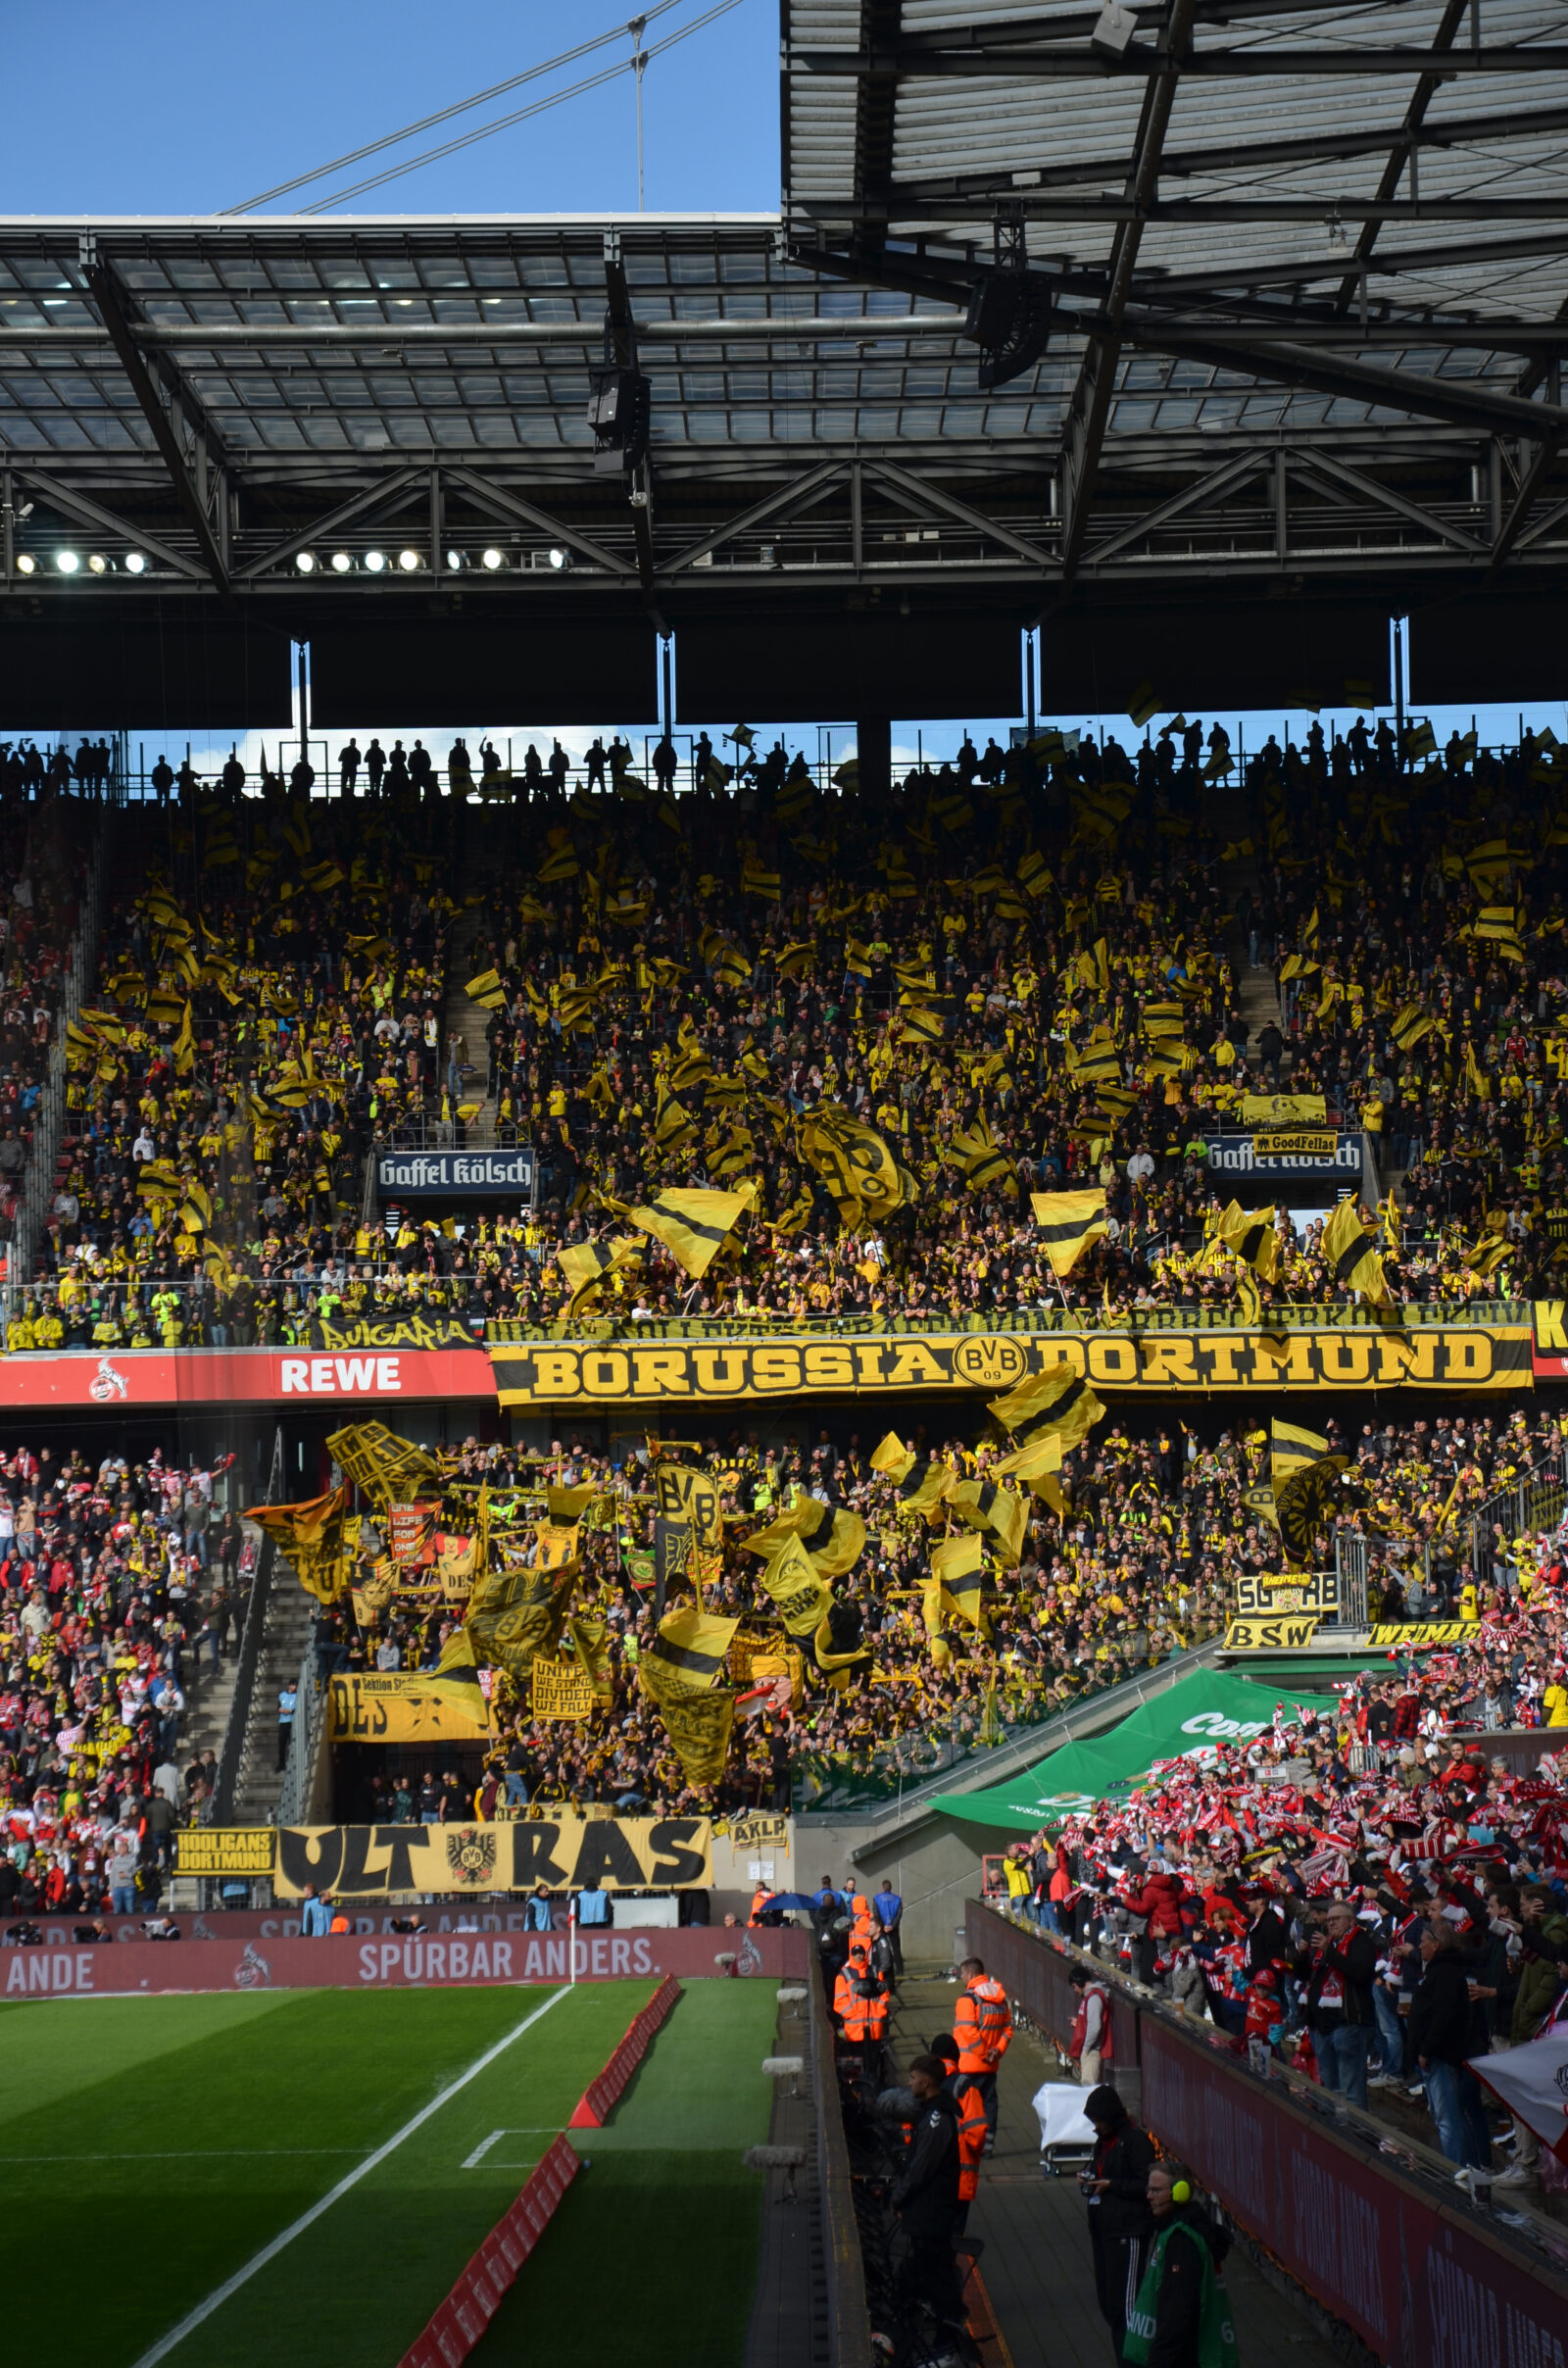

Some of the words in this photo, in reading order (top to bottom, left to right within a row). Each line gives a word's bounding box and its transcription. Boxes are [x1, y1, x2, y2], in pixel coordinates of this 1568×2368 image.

[1272, 1136, 1334, 1150] GoodFellas
[379, 1158, 449, 1187] Gaffel
[454, 1157, 531, 1186] Kölsch
[1535, 1301, 1568, 1348] K
[532, 1340, 949, 1394] BORUSSIA
[1035, 1334, 1493, 1381] DORTMUND
[965, 1340, 1018, 1370] BVB
[281, 1357, 401, 1393] REWE
[983, 1370, 1001, 1380] 09
[393, 1515, 423, 1526] LIFE
[393, 1529, 416, 1539] FOR
[394, 1542, 416, 1552] ONE
[1239, 1579, 1273, 1608] SG
[1230, 1621, 1314, 1648] BSW
[1374, 1622, 1482, 1645] WEIMAR
[362, 1677, 392, 1691] Sektion
[536, 1675, 554, 1686] WE
[536, 1687, 591, 1702] DIVIDED
[535, 1700, 557, 1712] WE
[560, 1702, 591, 1713] FALL
[734, 1819, 785, 1842] AKLP
[177, 1833, 270, 1851] HOOLIGANS
[177, 1850, 270, 1869] DORTMUND
[464, 1849, 481, 1863] BVB
[359, 1937, 513, 1980] SPÜRBAR
[524, 1938, 661, 1977] ANDERS.
[6, 1953, 94, 1992] ANDE
[1220, 2320, 1235, 2344] 6
